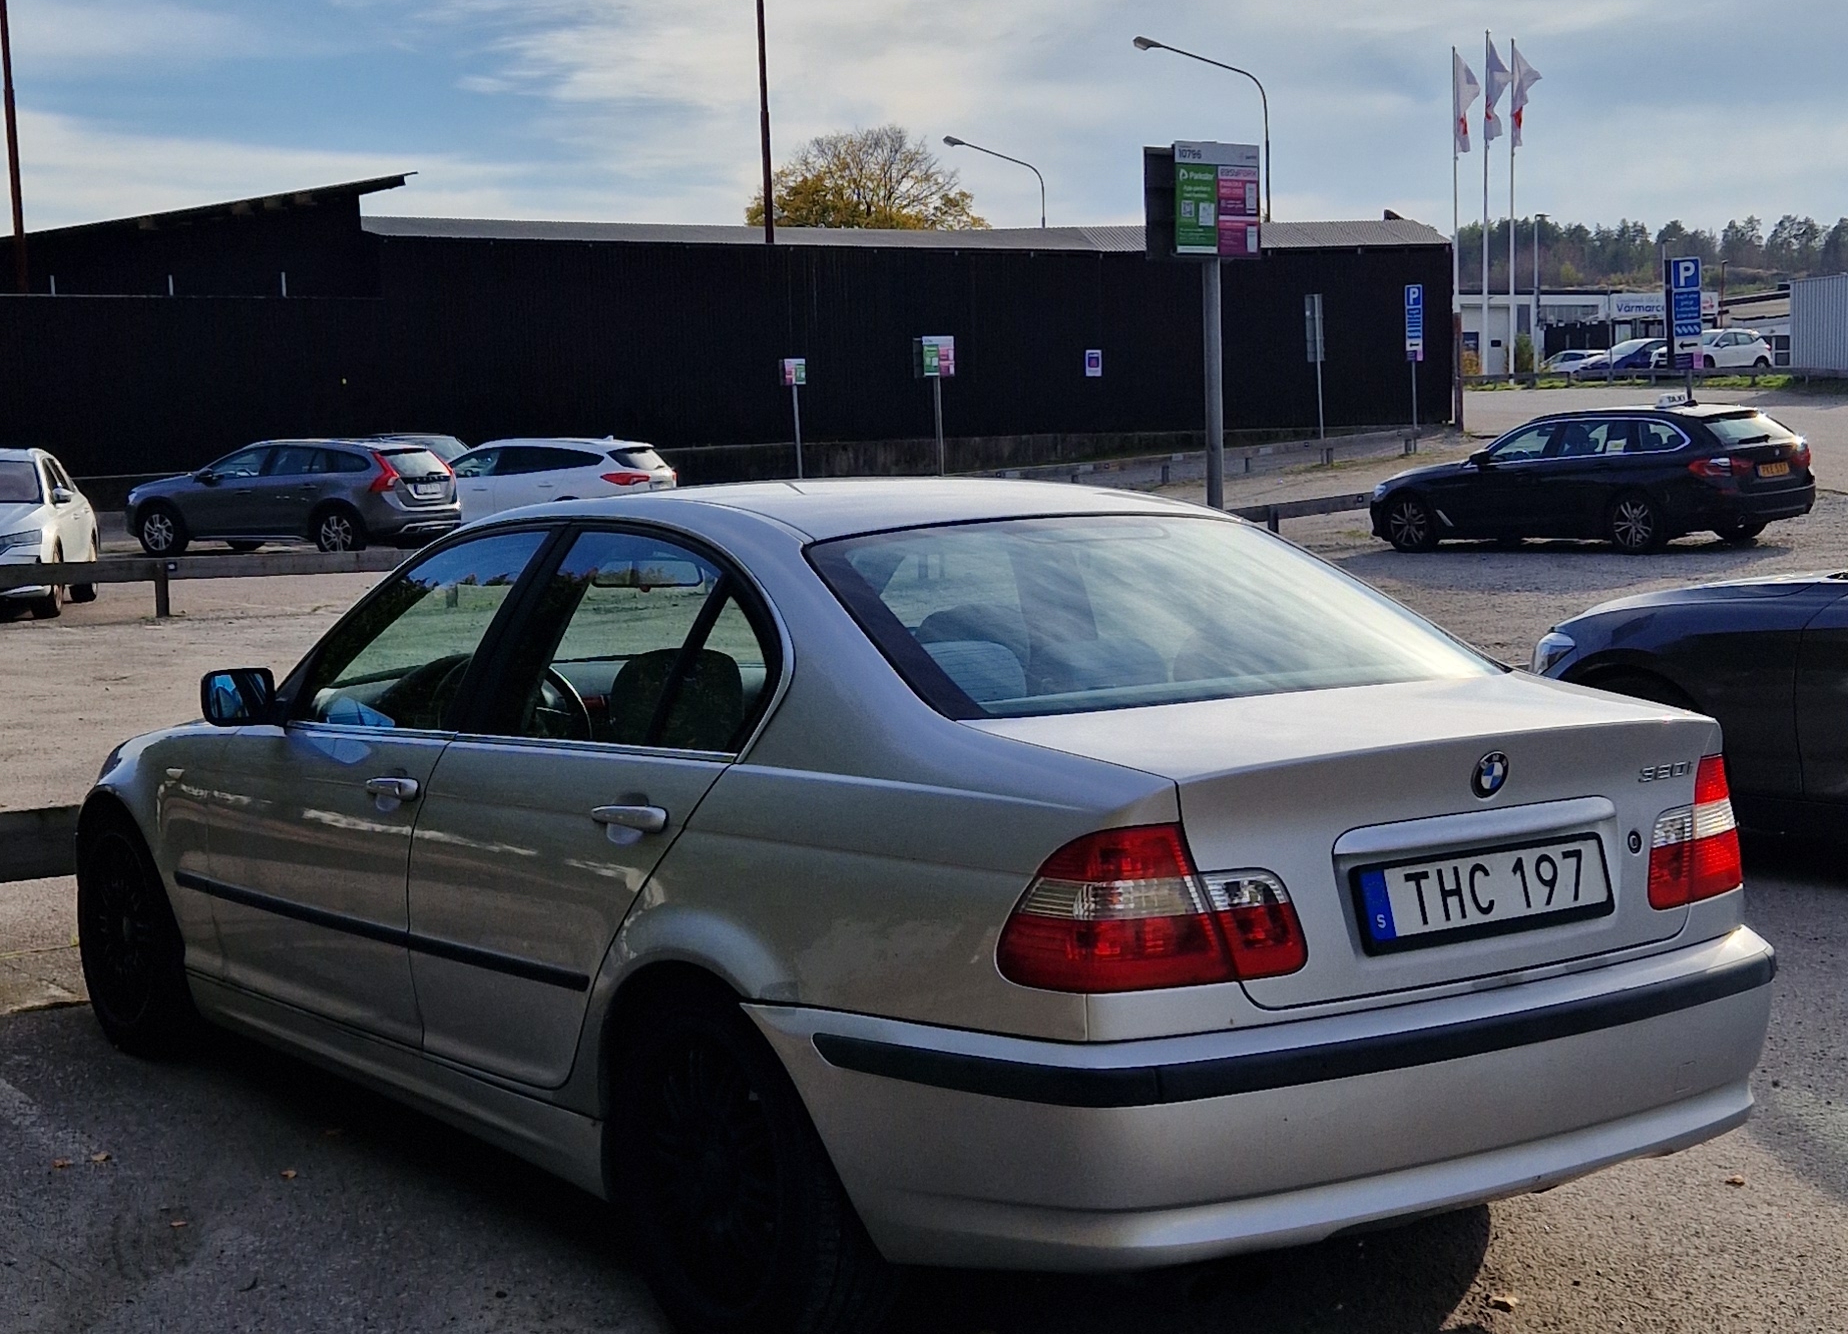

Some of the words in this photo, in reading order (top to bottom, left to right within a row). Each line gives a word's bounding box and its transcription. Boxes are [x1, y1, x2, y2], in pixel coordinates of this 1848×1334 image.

[1679, 261, 1696, 287] P
[1409, 287, 1419, 305] P
[1667, 394, 1686, 403] TAXI
[1404, 863, 1495, 926] THC
[1511, 848, 1583, 909] 197
[1376, 914, 1387, 929] S
